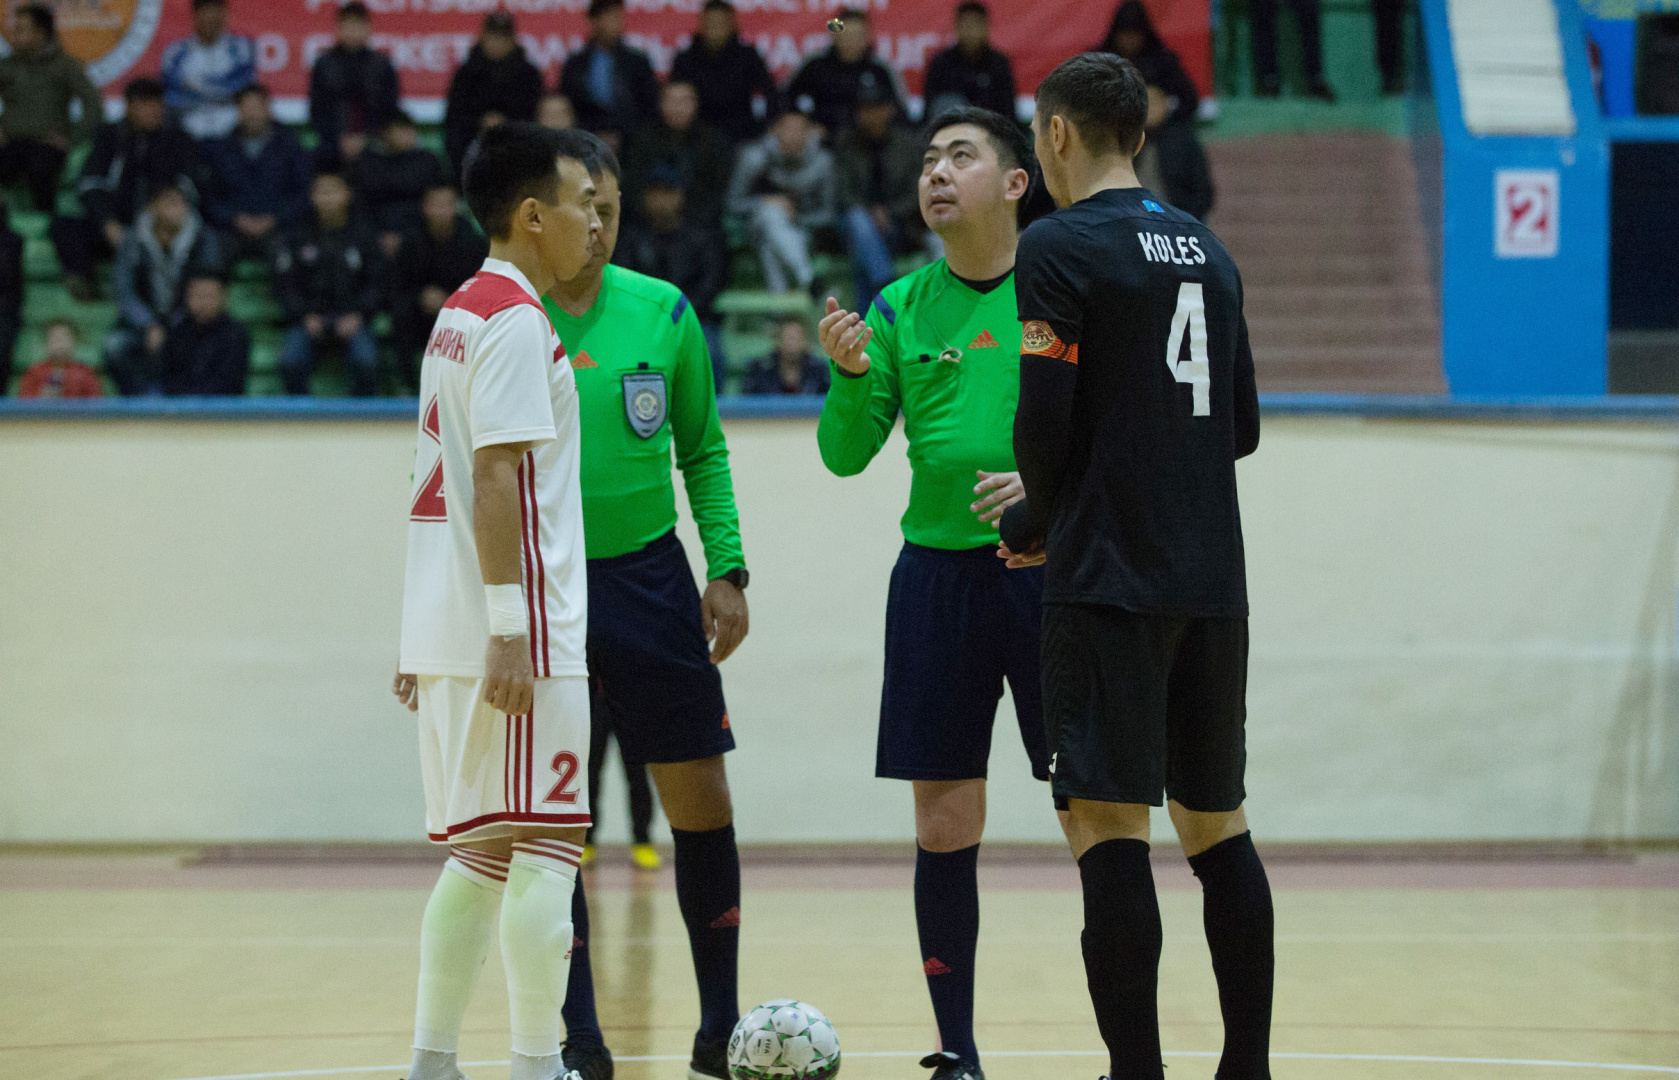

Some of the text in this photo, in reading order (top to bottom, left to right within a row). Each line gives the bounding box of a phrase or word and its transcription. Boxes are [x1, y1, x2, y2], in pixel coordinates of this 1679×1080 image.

[1508, 187, 1548, 241] 2
[1137, 231, 1206, 265] KOLES
[1166, 282, 1210, 416] 4
[410, 392, 448, 522] 2
[542, 750, 580, 804] 2
